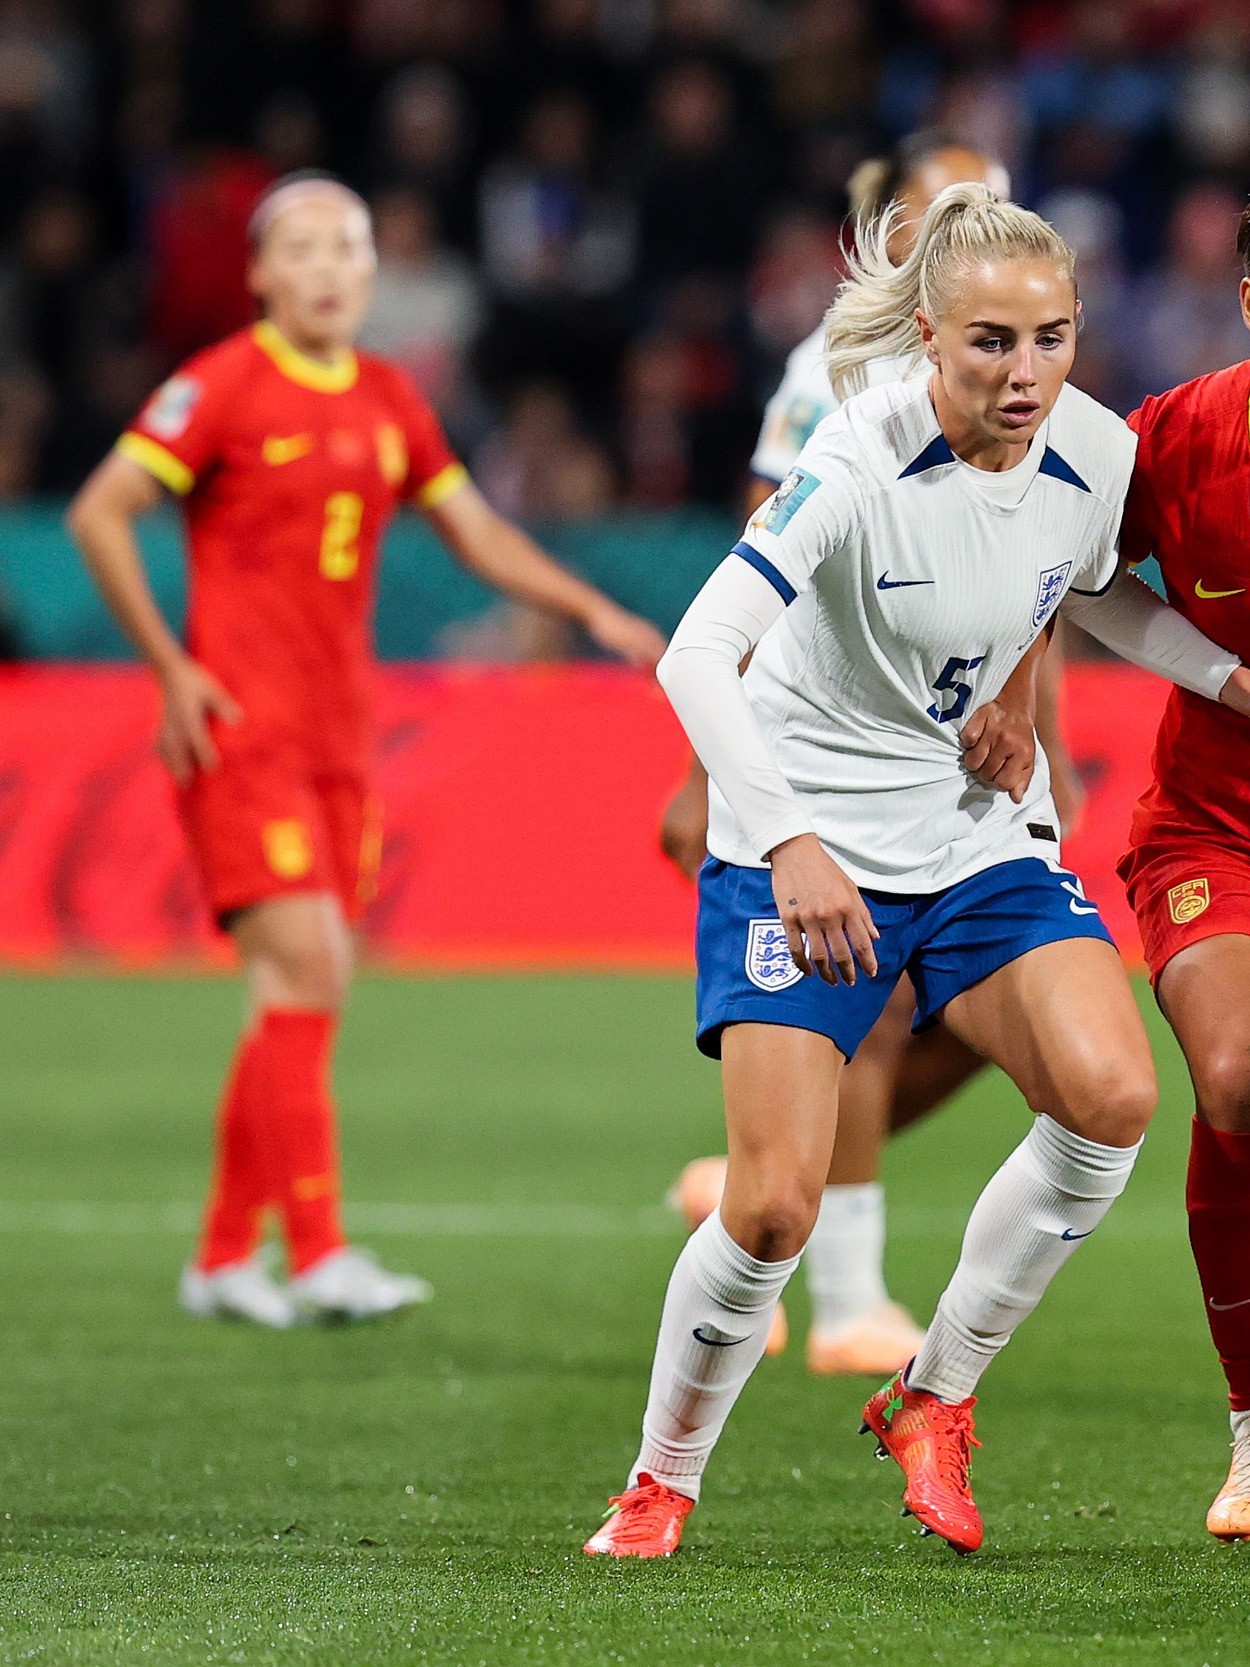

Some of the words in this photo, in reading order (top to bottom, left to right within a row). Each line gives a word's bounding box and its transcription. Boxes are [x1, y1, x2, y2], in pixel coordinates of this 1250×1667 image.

[319, 491, 364, 581] 2
[926, 656, 986, 724] 5
[1169, 881, 1204, 899] CFA
